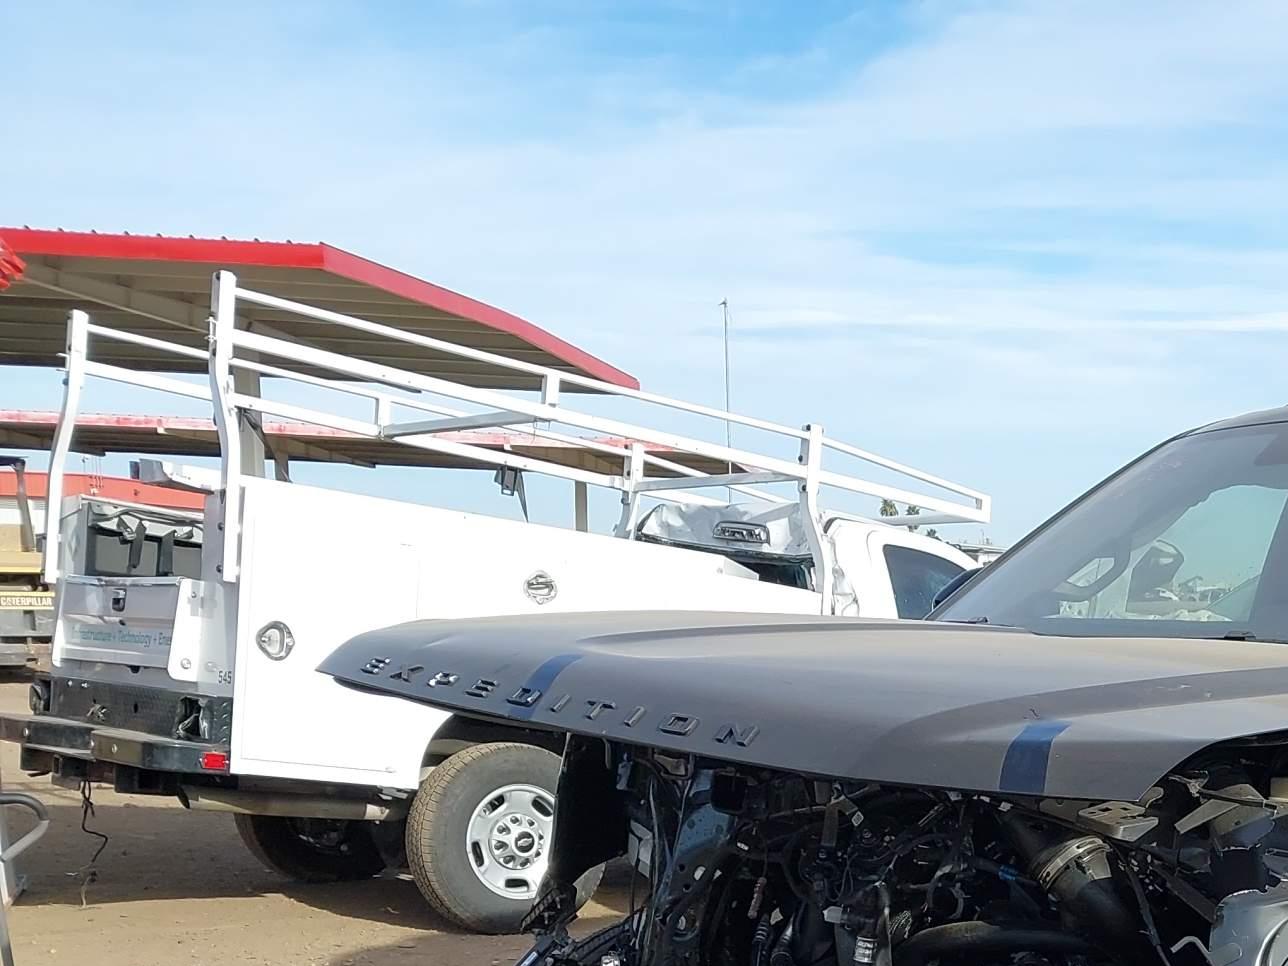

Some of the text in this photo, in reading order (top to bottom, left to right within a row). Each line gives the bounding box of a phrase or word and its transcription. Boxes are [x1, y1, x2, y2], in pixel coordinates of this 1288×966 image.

[0, 597, 52, 606] CATERPILLAR
[117, 629, 152, 648] Technology
[218, 670, 232, 684] 545
[360, 656, 759, 748] EXPEDITION
